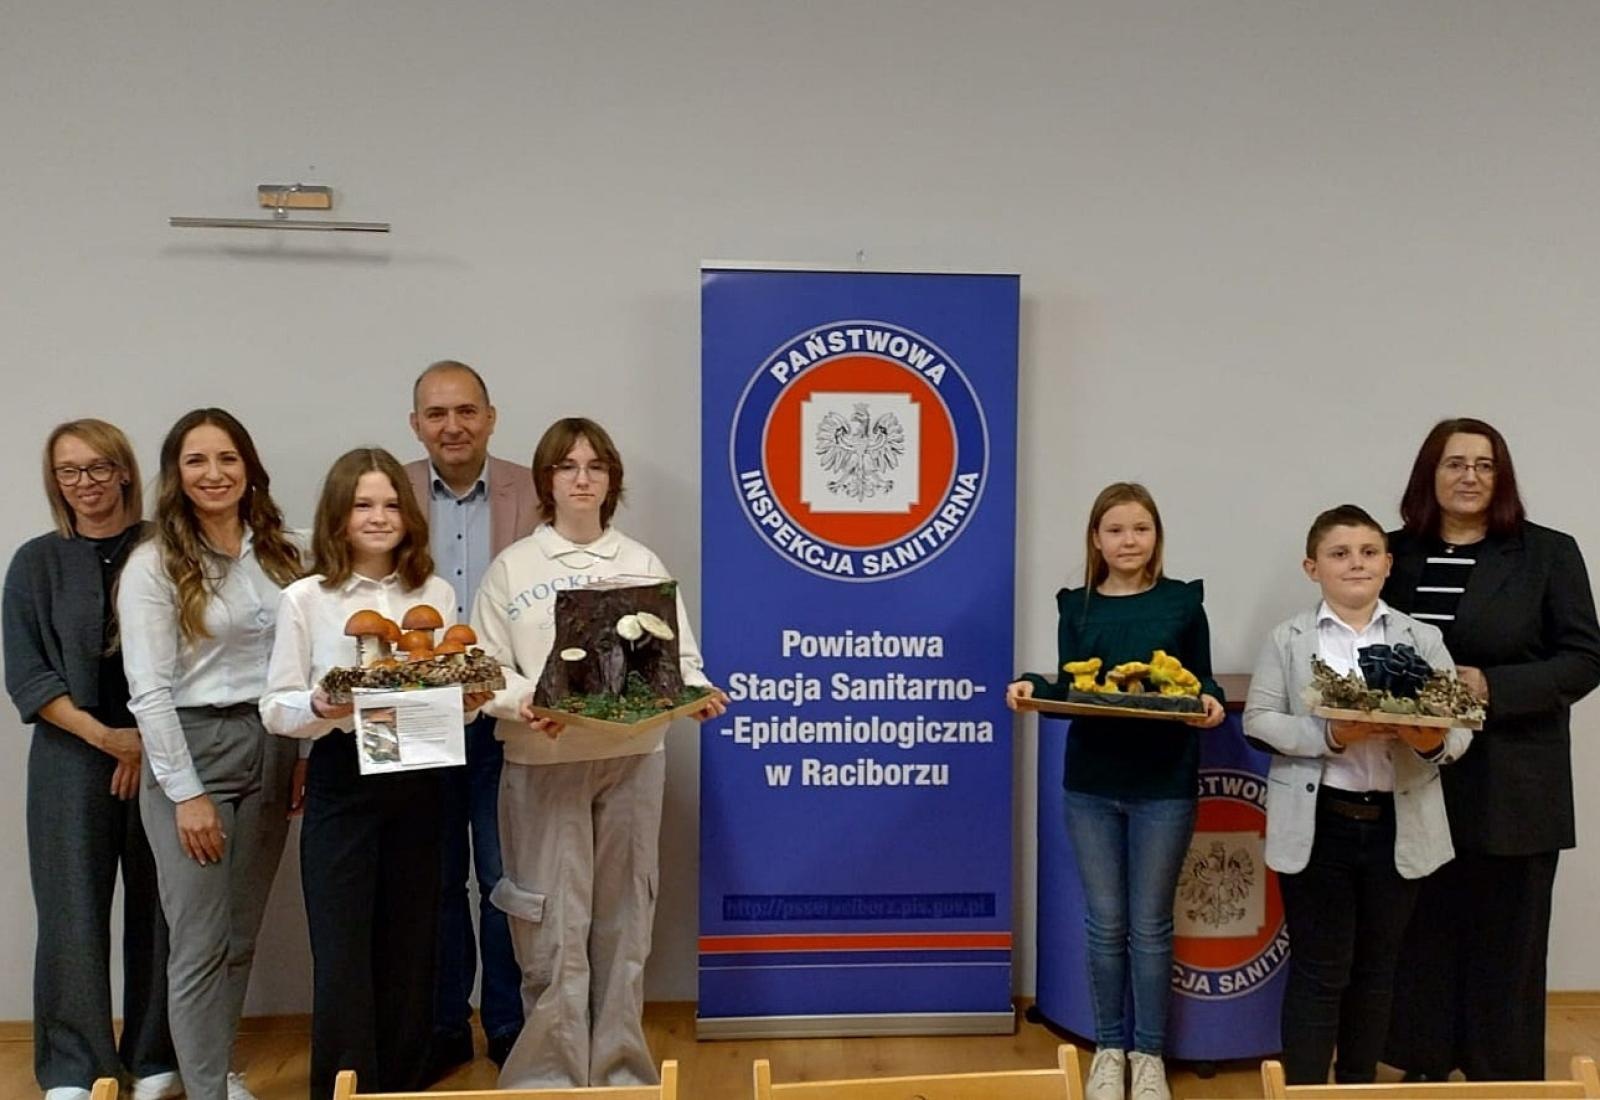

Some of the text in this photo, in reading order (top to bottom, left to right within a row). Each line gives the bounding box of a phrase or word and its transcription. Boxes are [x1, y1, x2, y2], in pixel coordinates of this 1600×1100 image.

[770, 329, 947, 386] PAŃSTWOWA
[740, 469, 979, 576] INSPEKCJA SANITARNA
[782, 629, 943, 658] Powiatowa
[729, 672, 986, 706] Stacja Sanitarno-
[720, 715, 993, 749] -Epidemiologiczna
[765, 758, 949, 786] w Raciborzu
